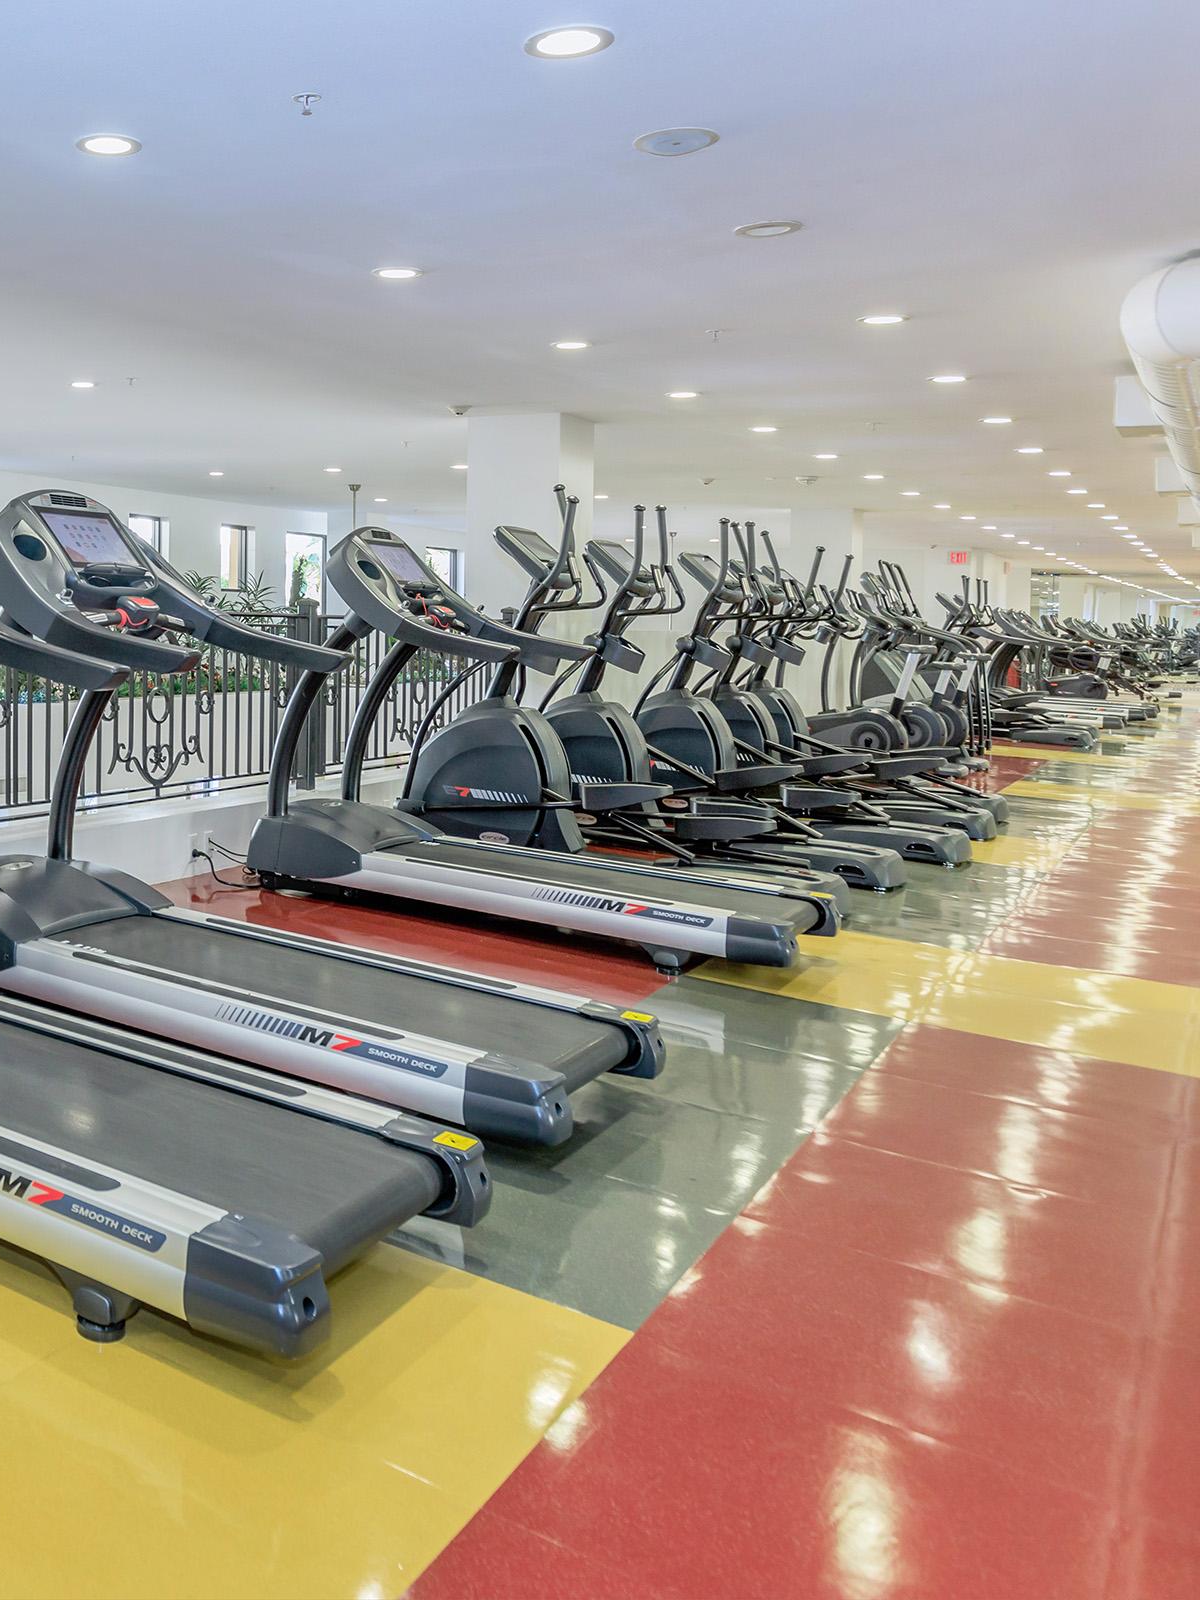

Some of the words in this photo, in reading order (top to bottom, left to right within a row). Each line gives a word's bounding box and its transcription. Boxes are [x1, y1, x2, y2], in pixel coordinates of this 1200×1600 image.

[950, 551, 967, 564] EXIT
[599, 899, 648, 915] M7
[652, 910, 684, 920] SMOOTH
[685, 915, 706, 924] DECK
[299, 1026, 362, 1051] M7
[367, 1047, 408, 1065] SMOOTH
[410, 1059, 438, 1073] DECK
[70, 1203, 119, 1230] SMOOTH
[121, 1223, 153, 1244] DECK
